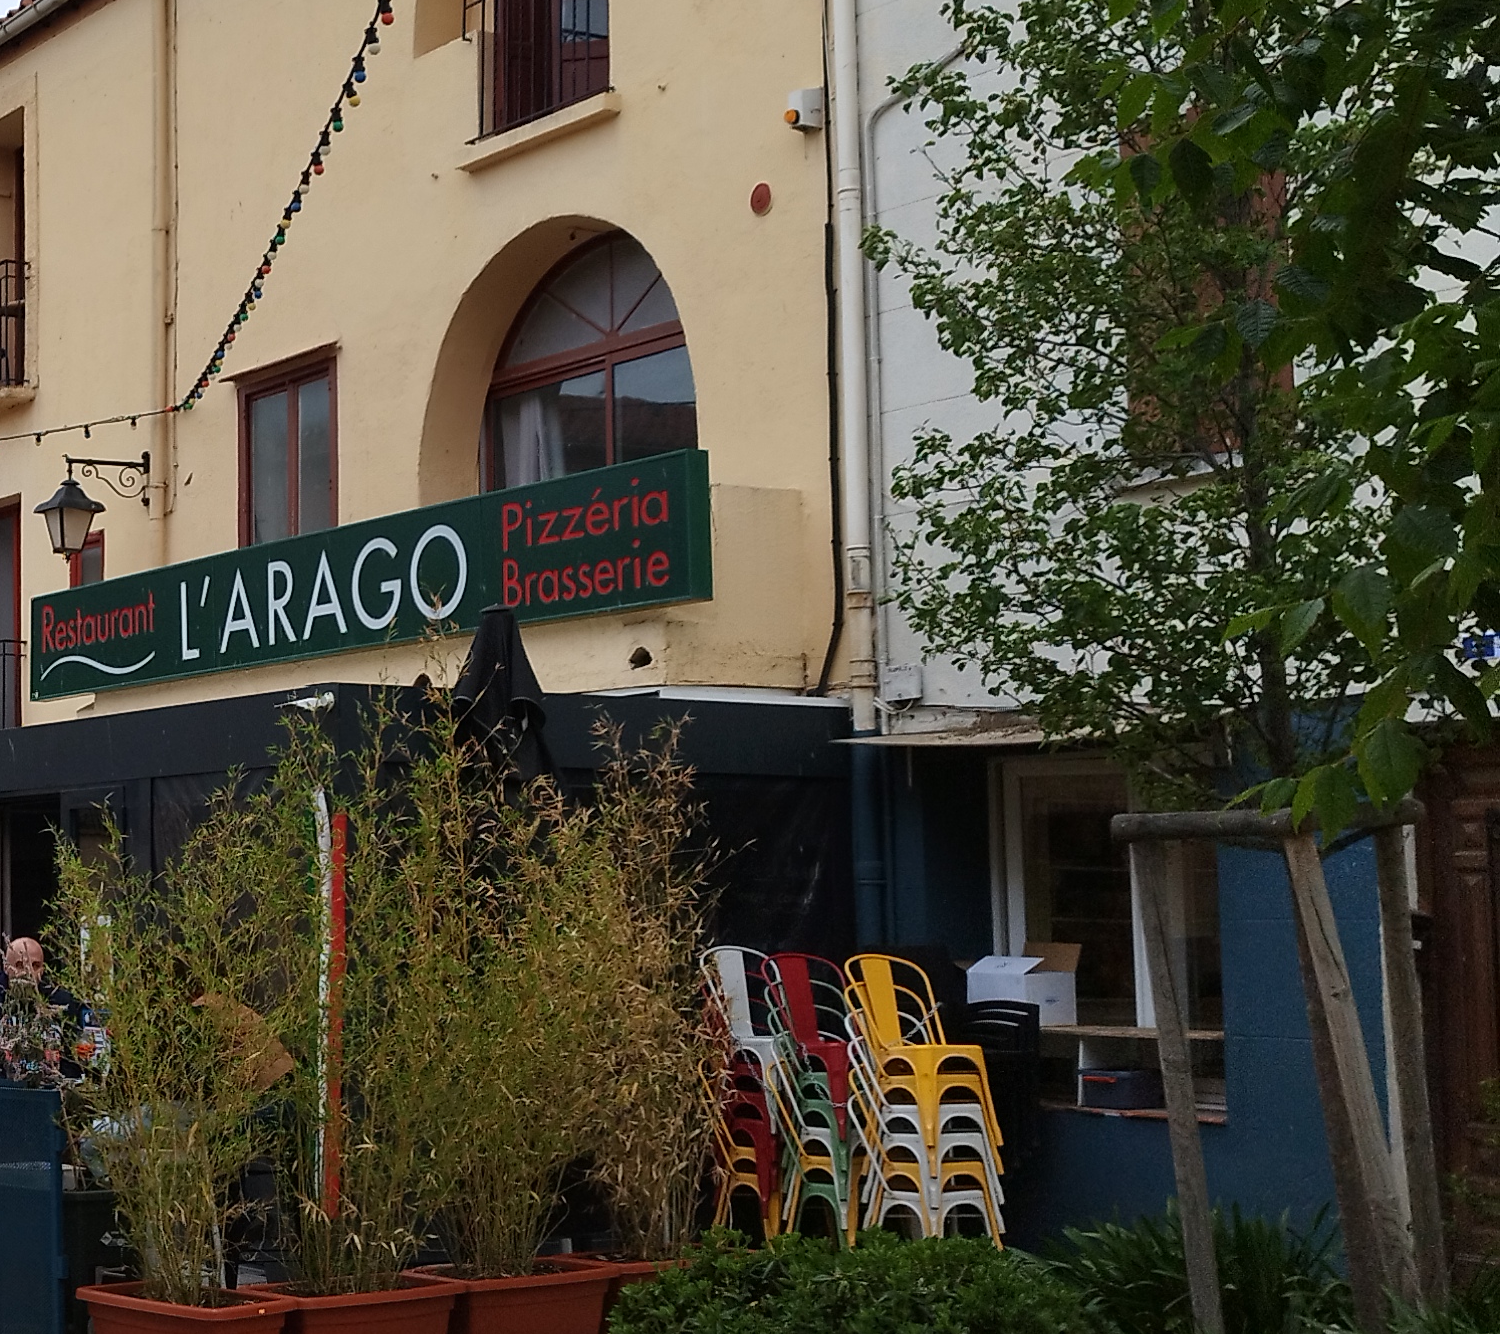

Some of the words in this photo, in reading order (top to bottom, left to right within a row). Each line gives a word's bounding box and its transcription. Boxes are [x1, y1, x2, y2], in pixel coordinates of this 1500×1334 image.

[502, 477, 668, 553] Pizzéria
[180, 524, 468, 661] L'ARAGO
[502, 538, 670, 608] Brasserie
[42, 590, 155, 654] Restaurant
